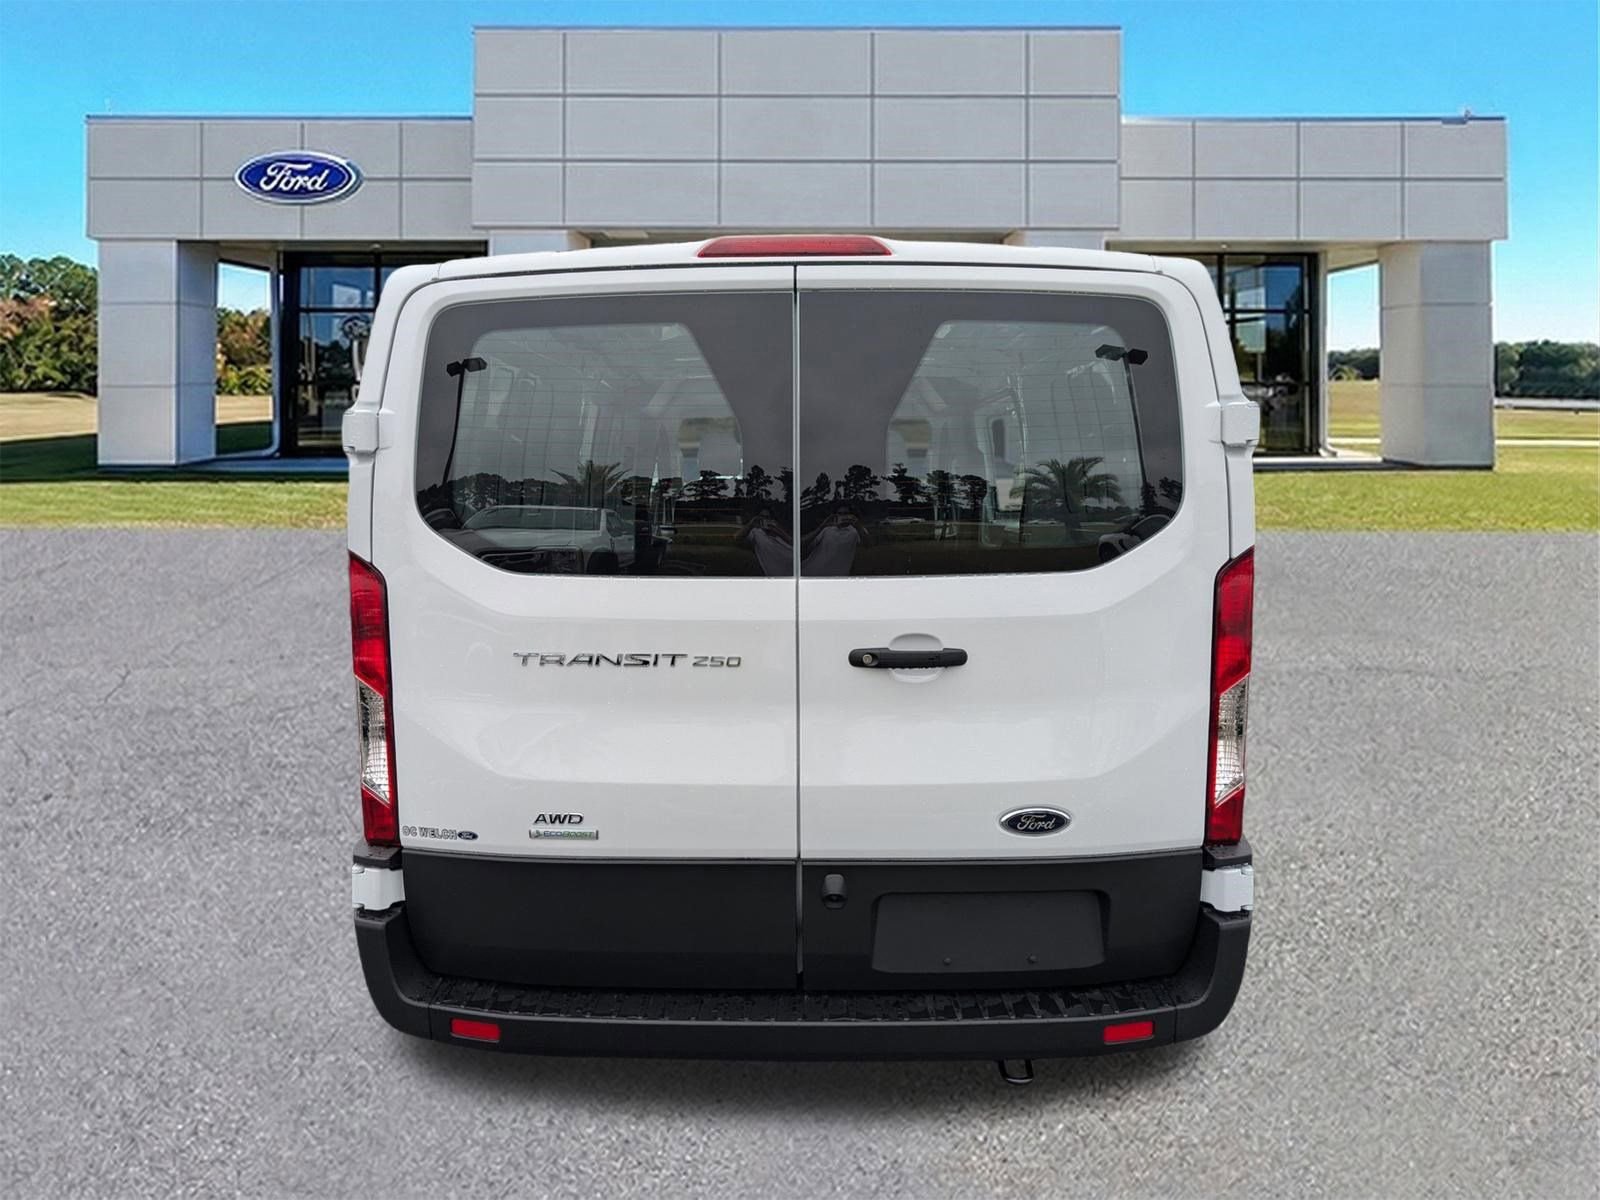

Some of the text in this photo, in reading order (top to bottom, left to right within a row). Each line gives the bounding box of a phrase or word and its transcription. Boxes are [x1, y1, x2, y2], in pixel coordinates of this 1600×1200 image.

[260, 162, 330, 191] Ford
[513, 652, 742, 668] TRANSIT 250
[533, 813, 584, 825] AWD
[1017, 814, 1056, 830] Ford
[418, 826, 458, 840] WELCH
